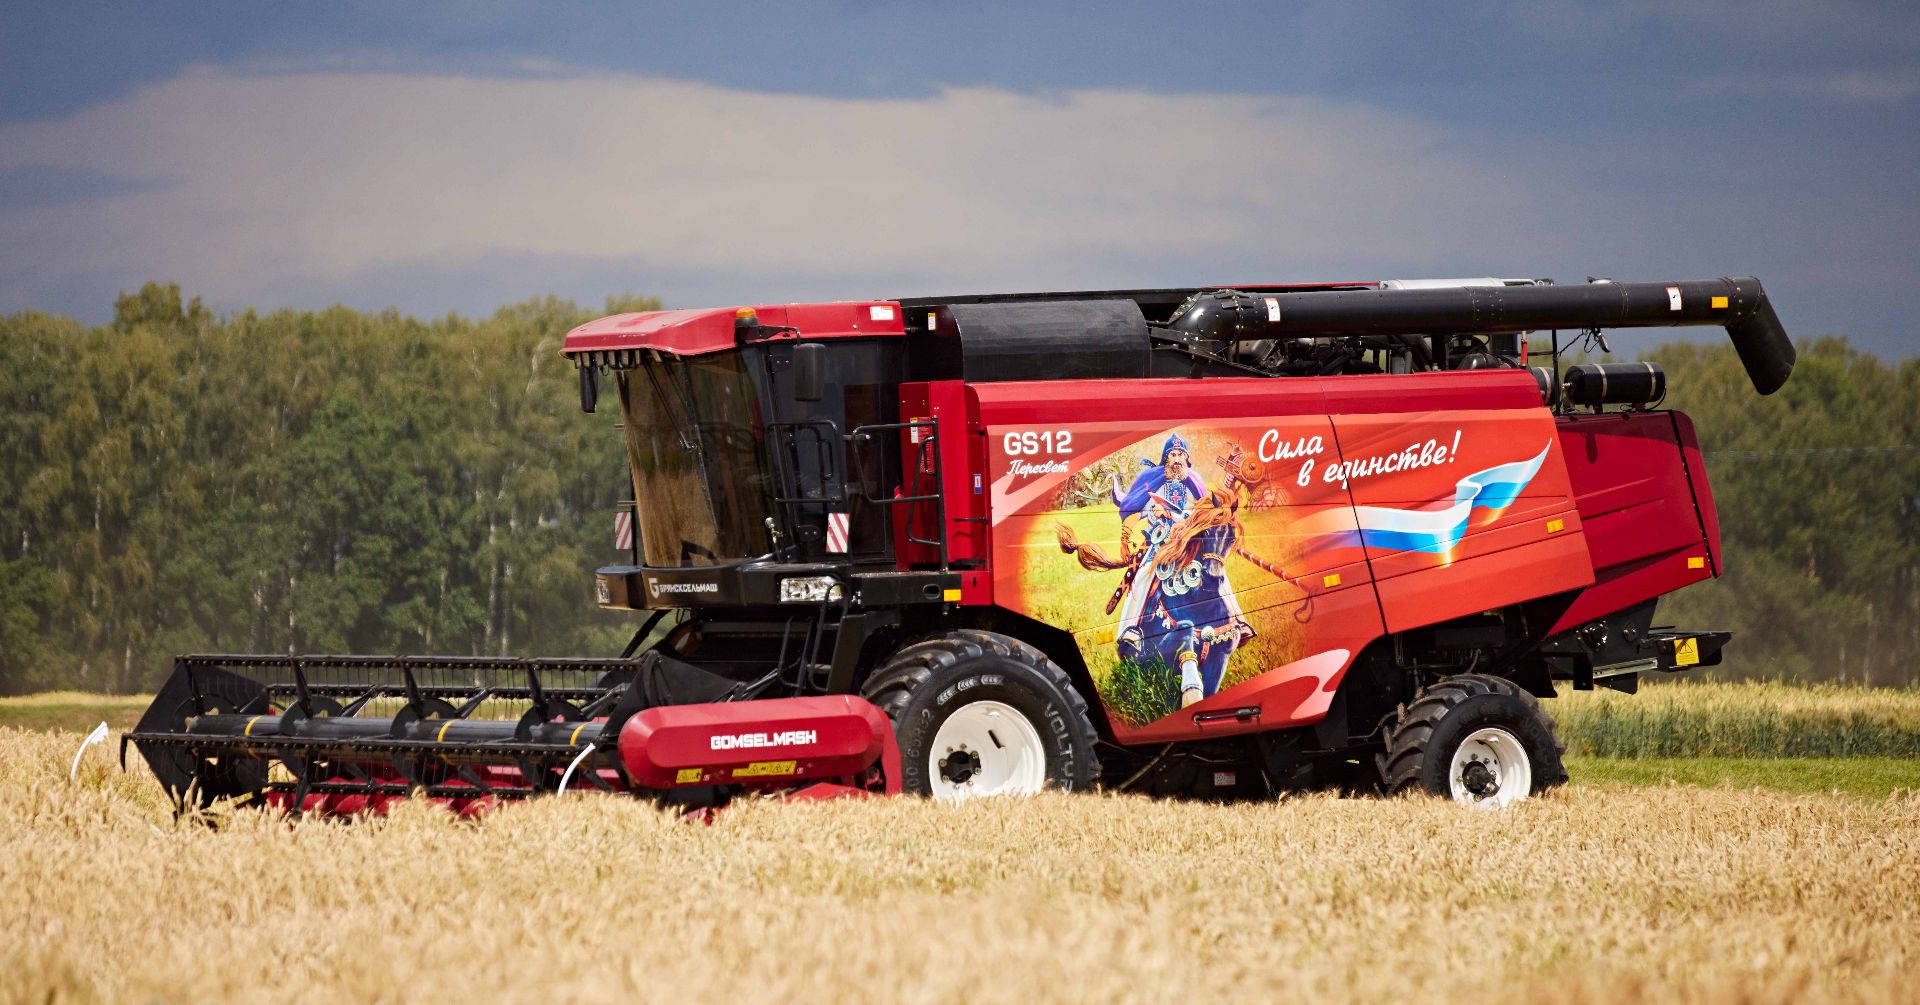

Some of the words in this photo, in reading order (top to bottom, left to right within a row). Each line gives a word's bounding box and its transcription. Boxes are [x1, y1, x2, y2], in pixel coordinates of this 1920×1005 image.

[1003, 430, 1073, 456] GS12
[1258, 429, 1325, 463] Сила
[1006, 459, 1070, 479] Пересвет
[1296, 458, 1315, 487] в
[1322, 430, 1462, 490] единстве!
[710, 730, 817, 750] GOMSELMASH
